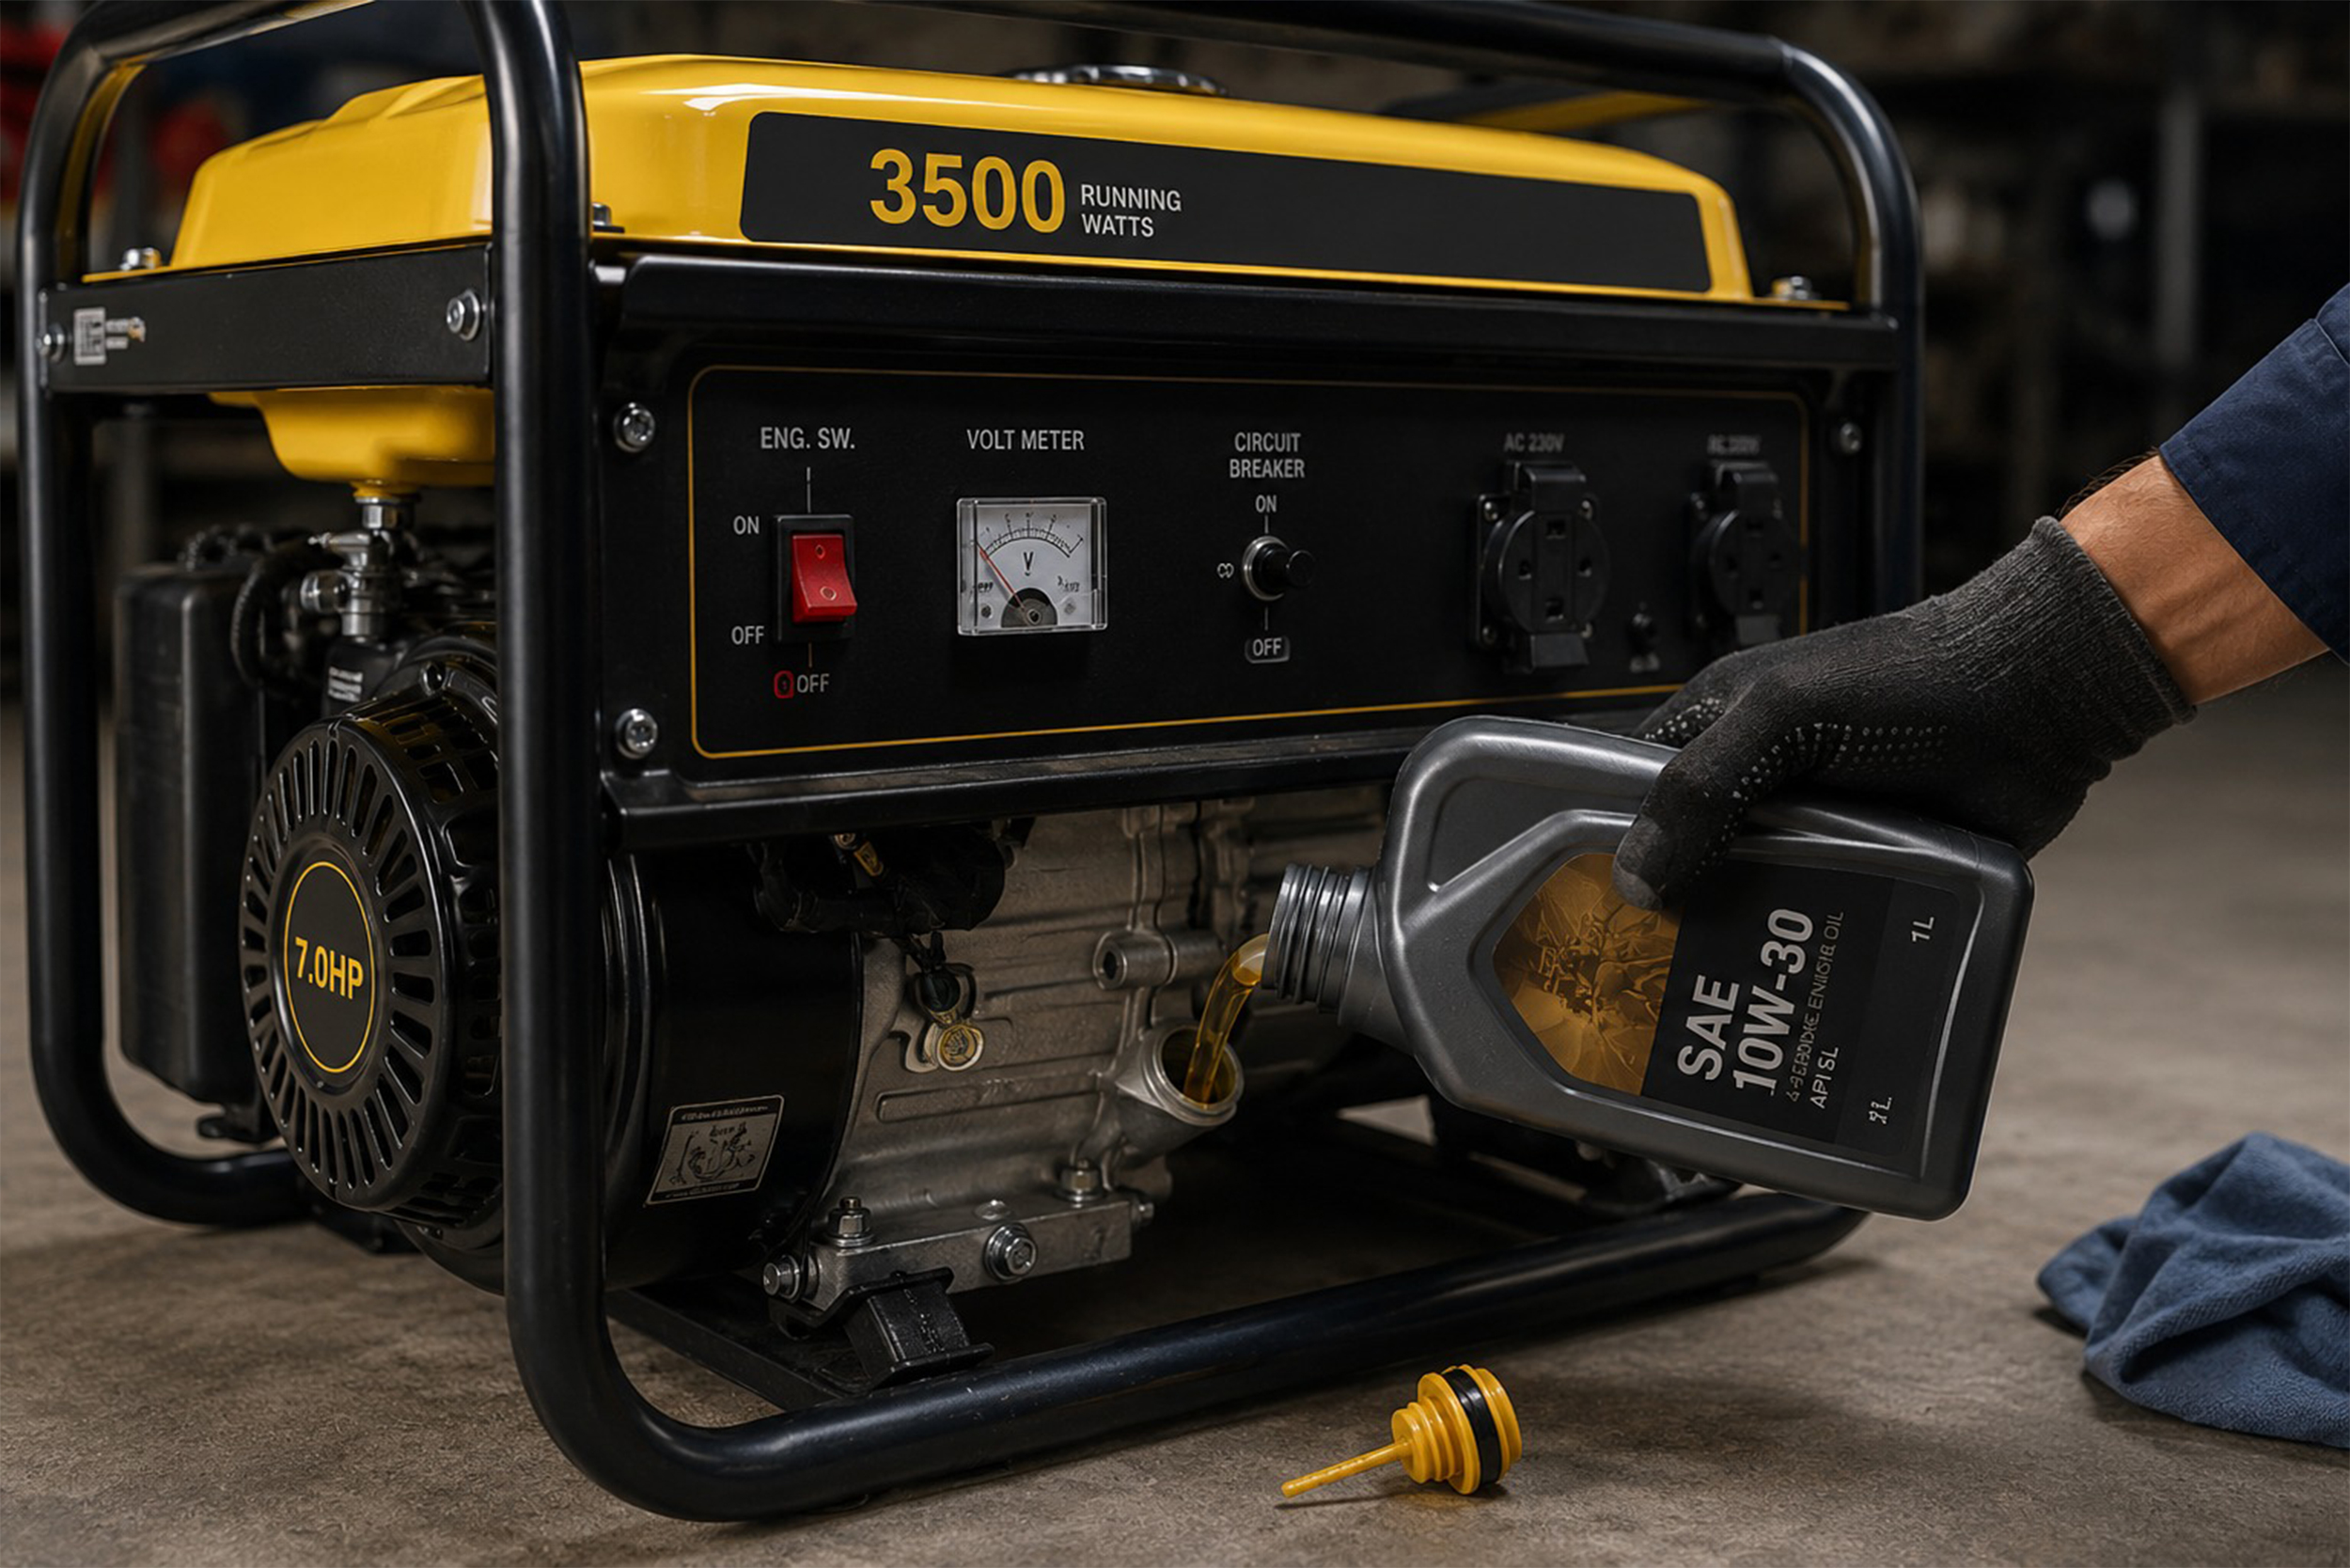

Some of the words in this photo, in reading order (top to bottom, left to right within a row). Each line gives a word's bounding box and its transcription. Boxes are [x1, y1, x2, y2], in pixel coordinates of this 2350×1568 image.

[870, 149, 1066, 234] 3500
[1080, 184, 1183, 212] RUNNING
[1082, 212, 1154, 238] WATTS
[760, 427, 811, 449] ENG.
[818, 427, 856, 449] SW.
[966, 429, 1015, 450] VOLT
[1021, 430, 1085, 451] METER
[1234, 431, 1302, 452] CIRCUIT
[1504, 433, 1525, 452] AC
[1230, 459, 1306, 478] BREAKER
[1255, 494, 1277, 513] ON
[733, 515, 760, 535] ON
[730, 625, 765, 646] OFF
[1252, 637, 1283, 656] OFF
[796, 673, 830, 694] OFF
[1823, 911, 1844, 940] OIL
[294, 936, 364, 1000] 7.0HP
[1732, 908, 1814, 1091] 10W-30
[1677, 974, 1740, 1081] SAE
[1810, 1074, 1832, 1109] API
